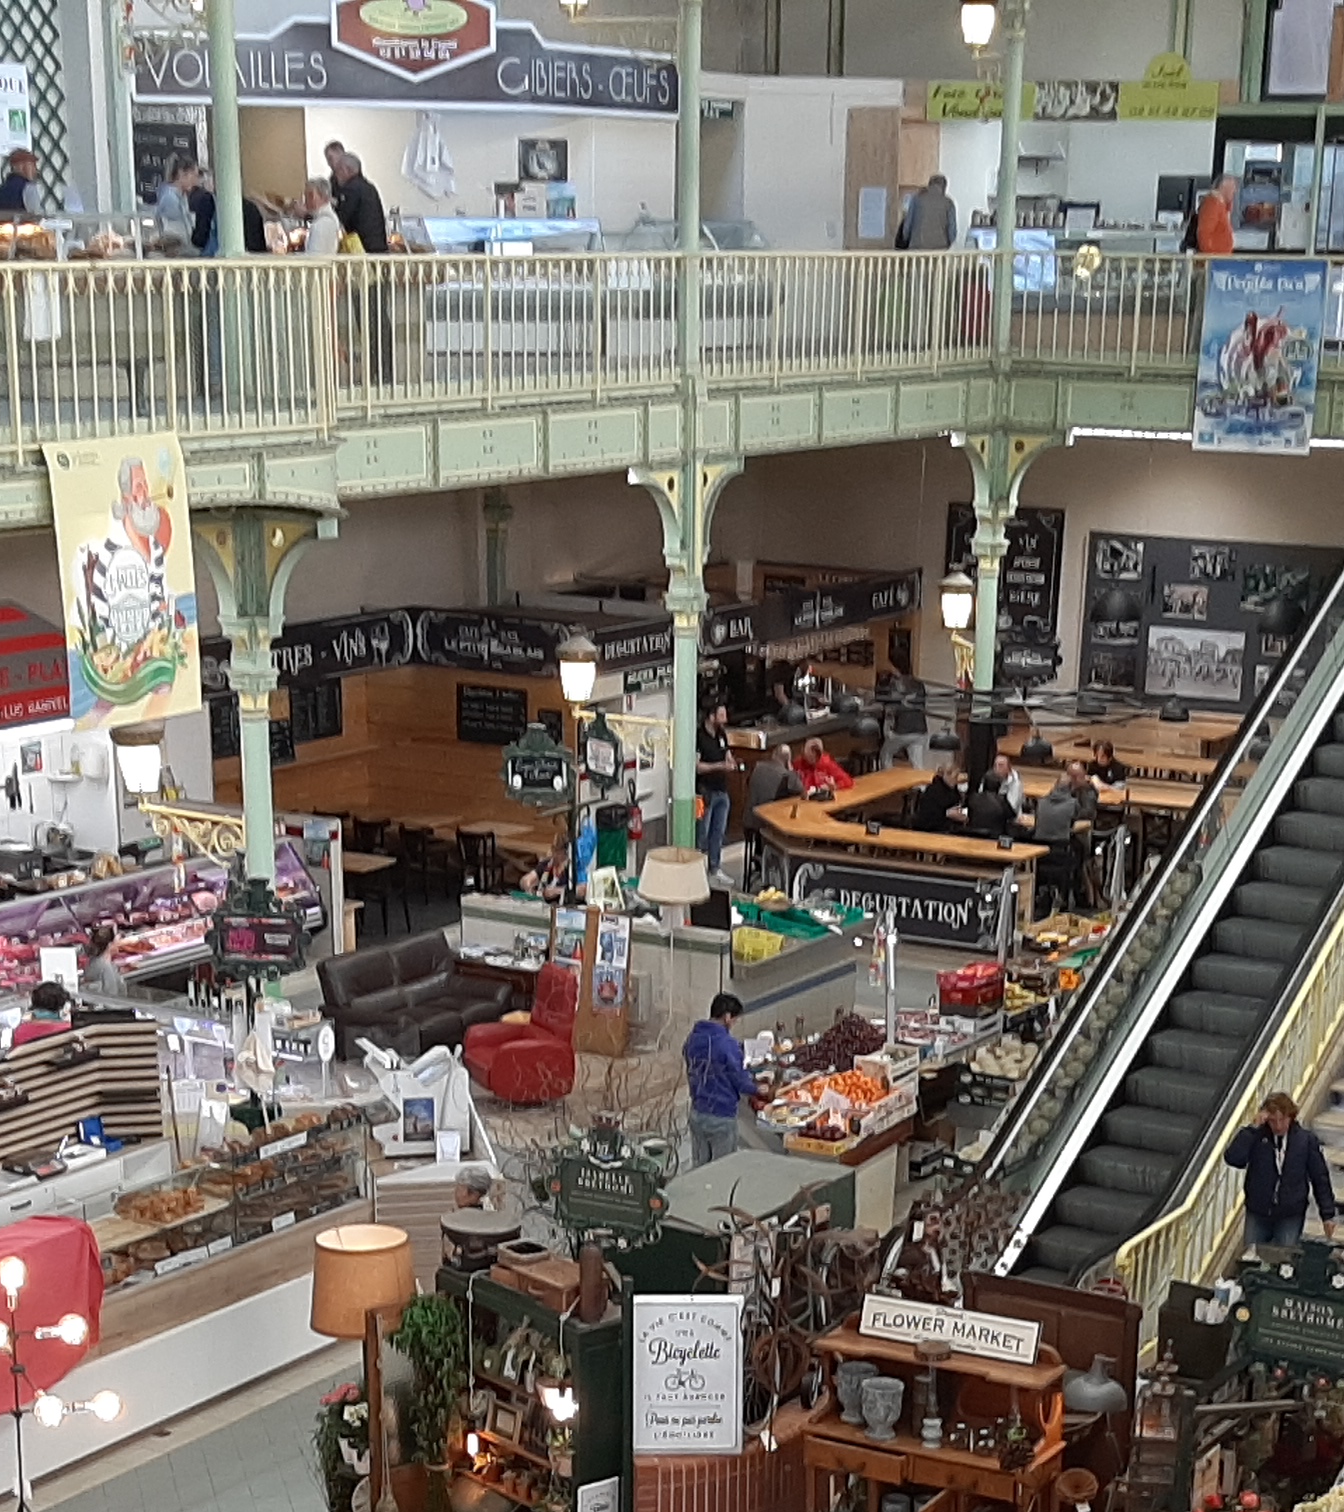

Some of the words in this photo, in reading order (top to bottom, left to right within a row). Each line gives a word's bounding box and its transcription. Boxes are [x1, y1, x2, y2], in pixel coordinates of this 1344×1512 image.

[145, 49, 329, 92] VOLILLES
[496, 60, 593, 100] GIBIERS
[332, 626, 367, 665] VINS
[647, 1336, 722, 1367] Bicyclette
[870, 1311, 946, 1335] FLOWER
[951, 1320, 1025, 1353] MARKET
